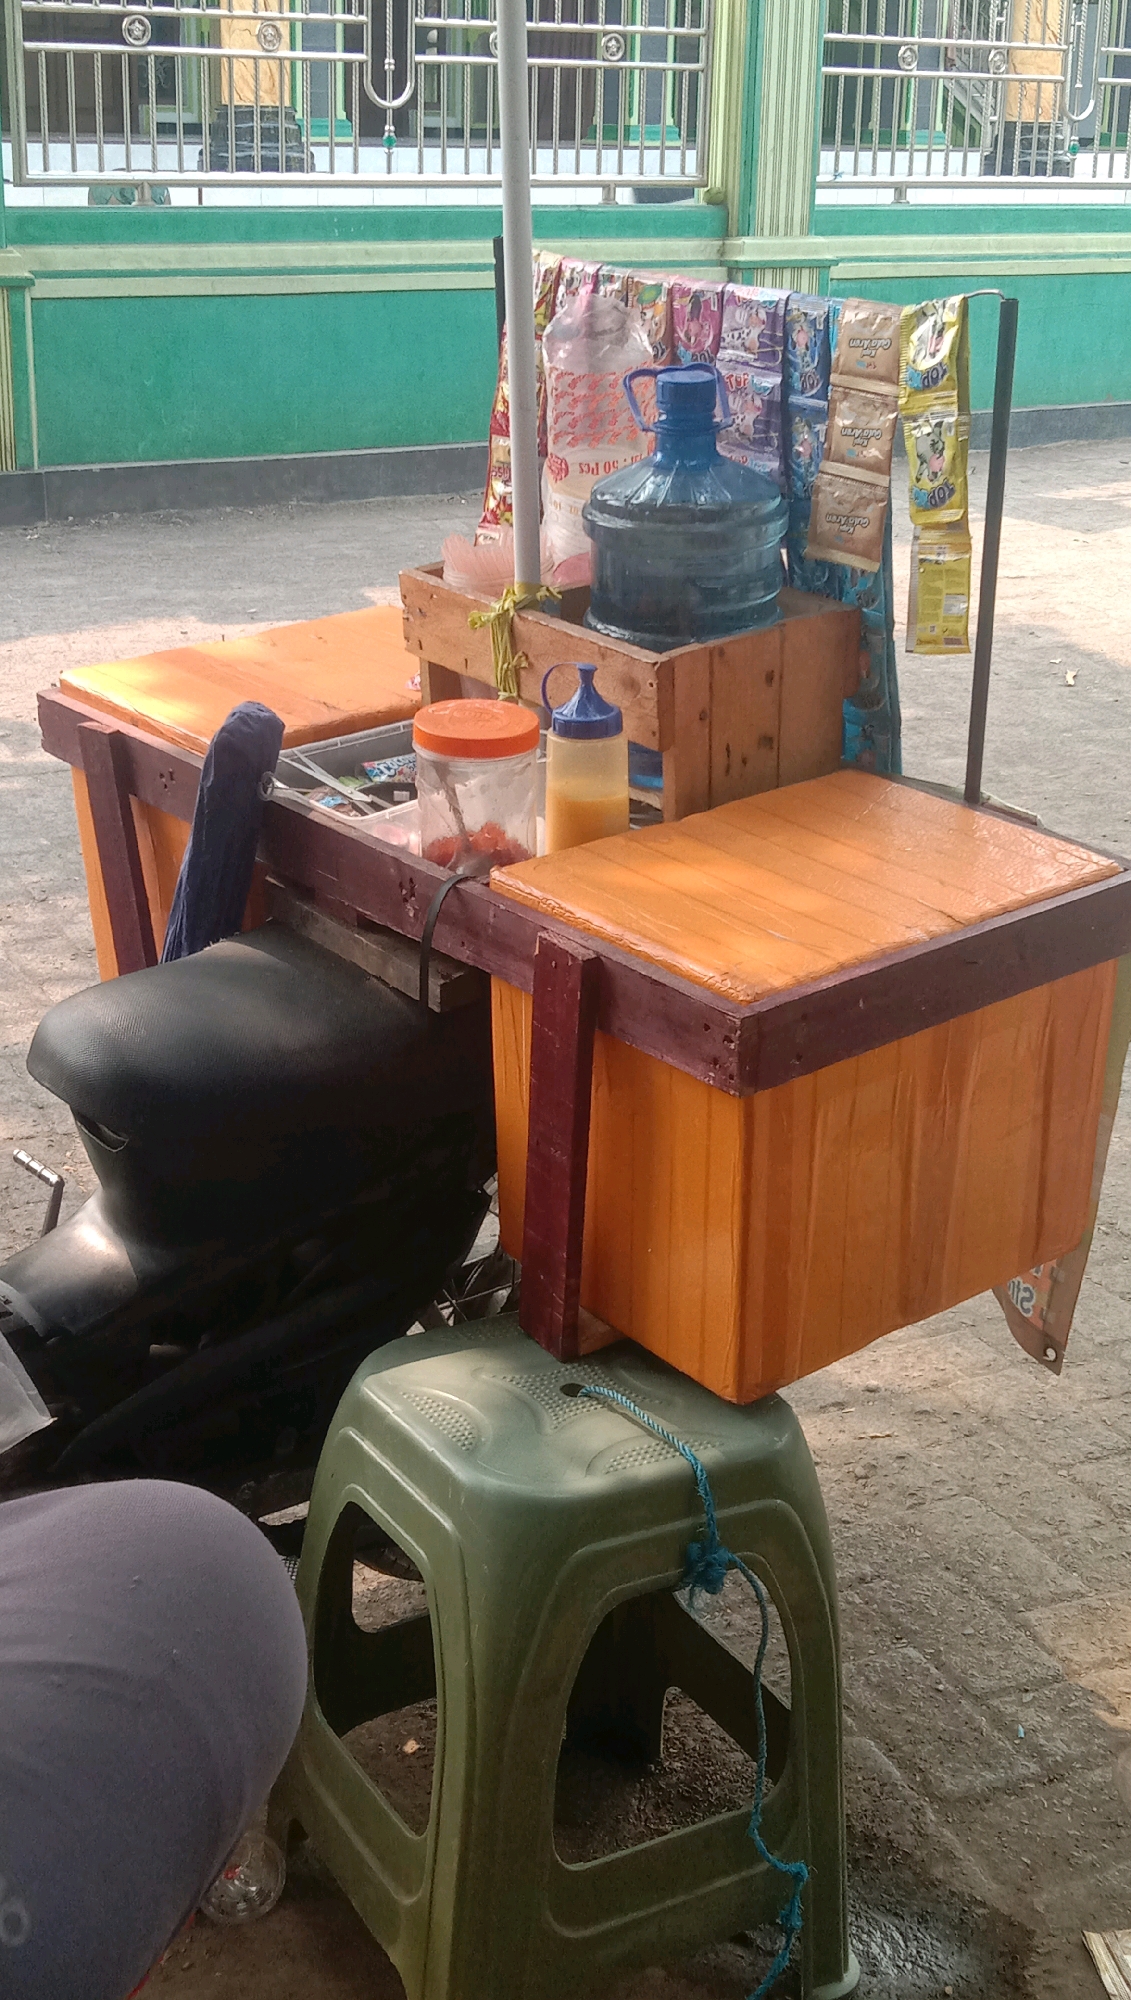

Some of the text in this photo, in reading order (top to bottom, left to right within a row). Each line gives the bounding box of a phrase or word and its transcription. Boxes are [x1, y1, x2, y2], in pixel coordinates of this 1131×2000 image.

[921, 361, 949, 391] TOP
[578, 462, 600, 476] Pcs
[928, 477, 956, 510] TOP
